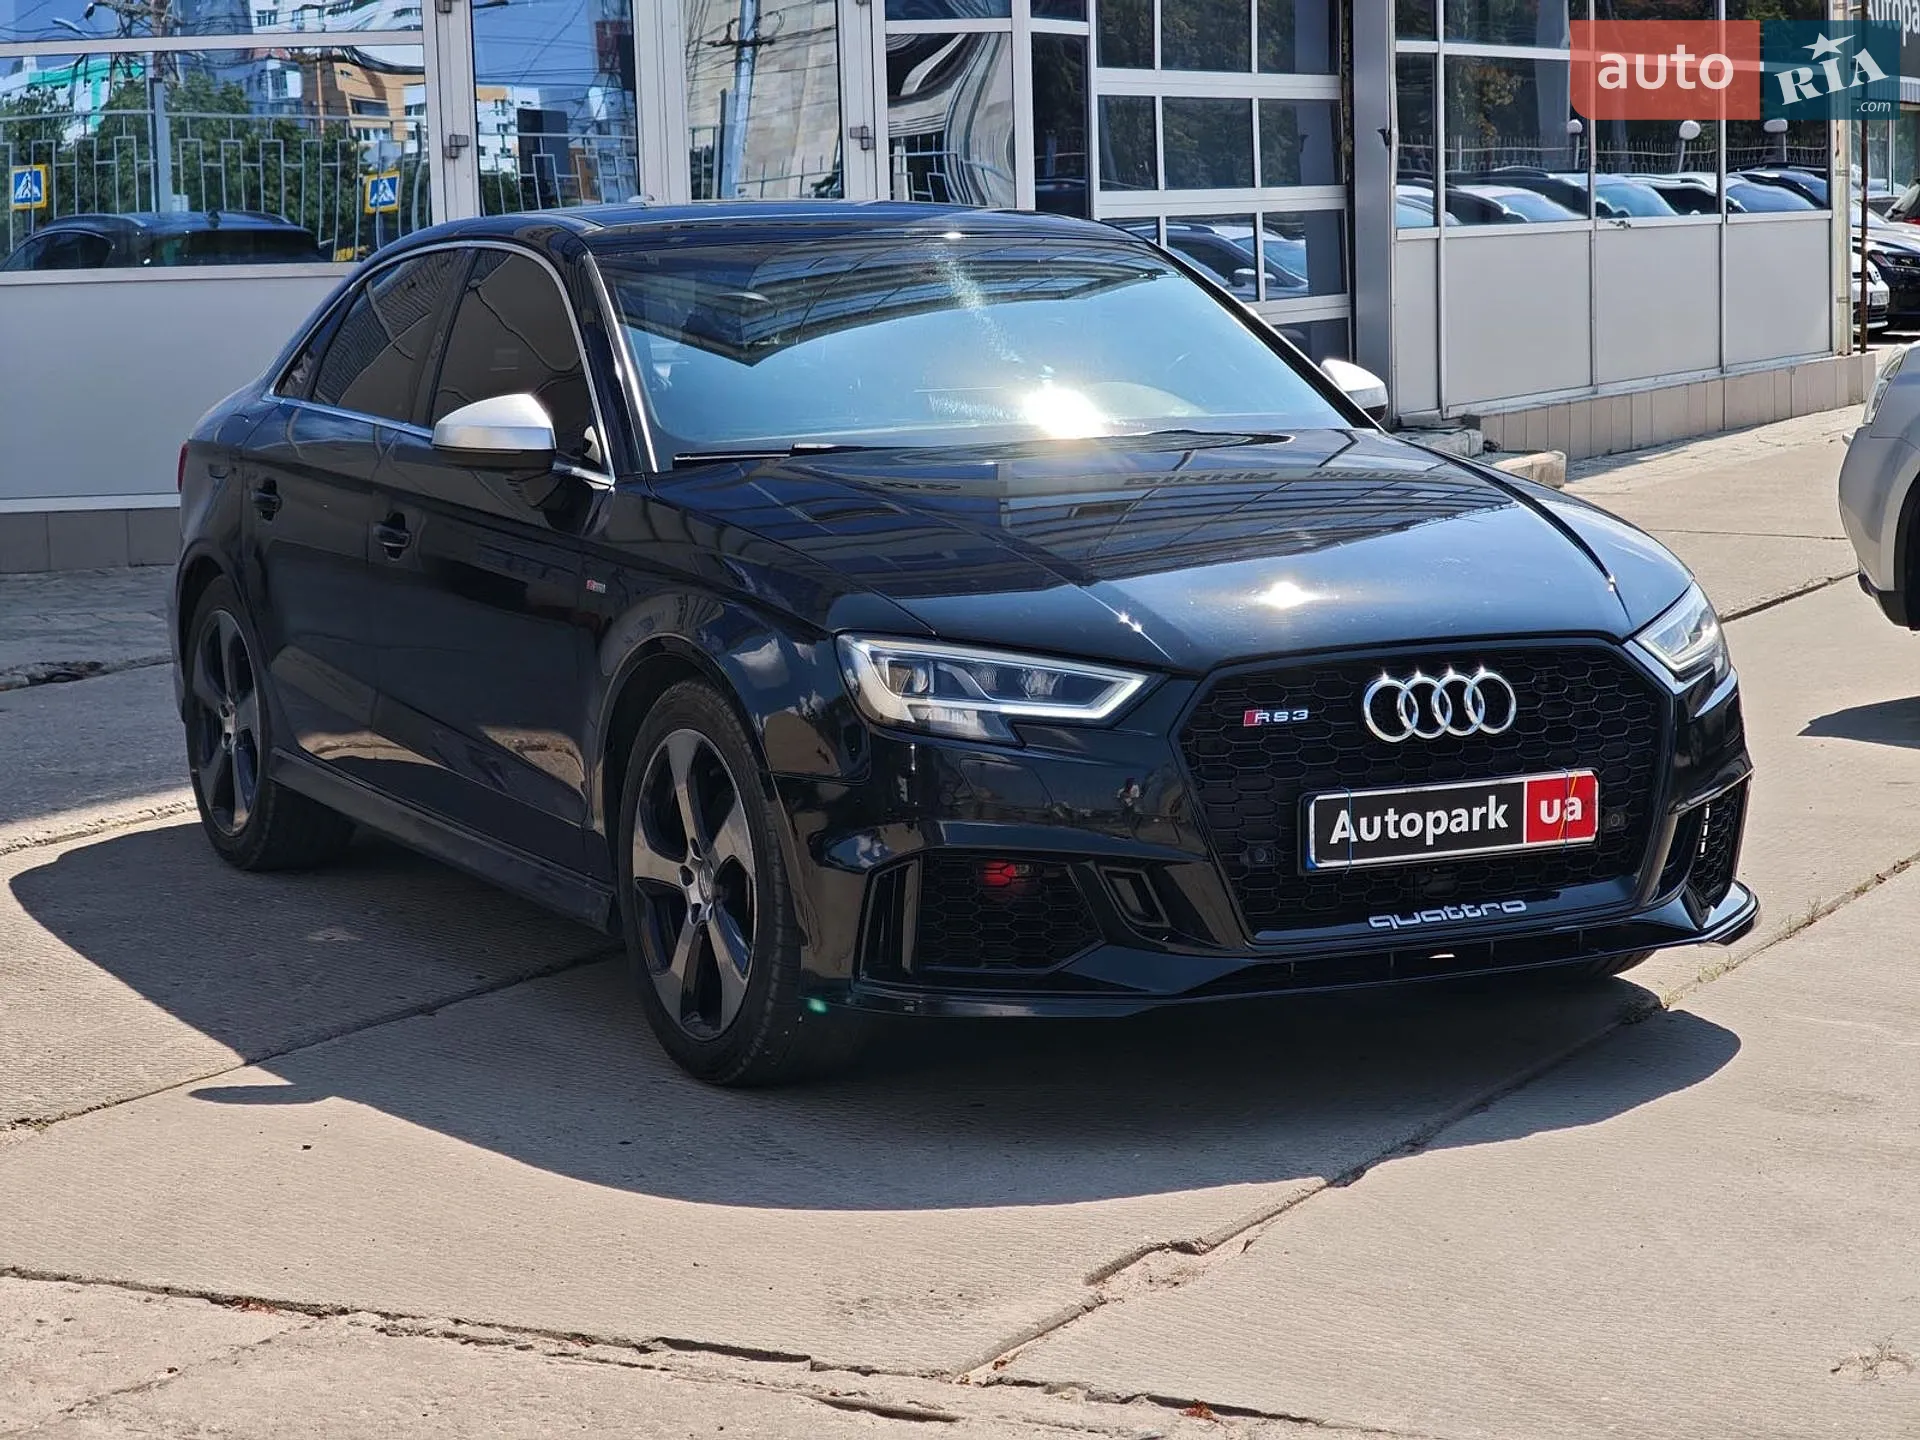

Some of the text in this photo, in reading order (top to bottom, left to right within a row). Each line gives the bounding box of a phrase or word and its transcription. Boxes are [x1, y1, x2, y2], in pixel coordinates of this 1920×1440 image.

[1329, 795, 1583, 846] Autopark ua
[1368, 899, 1527, 930] quattro
